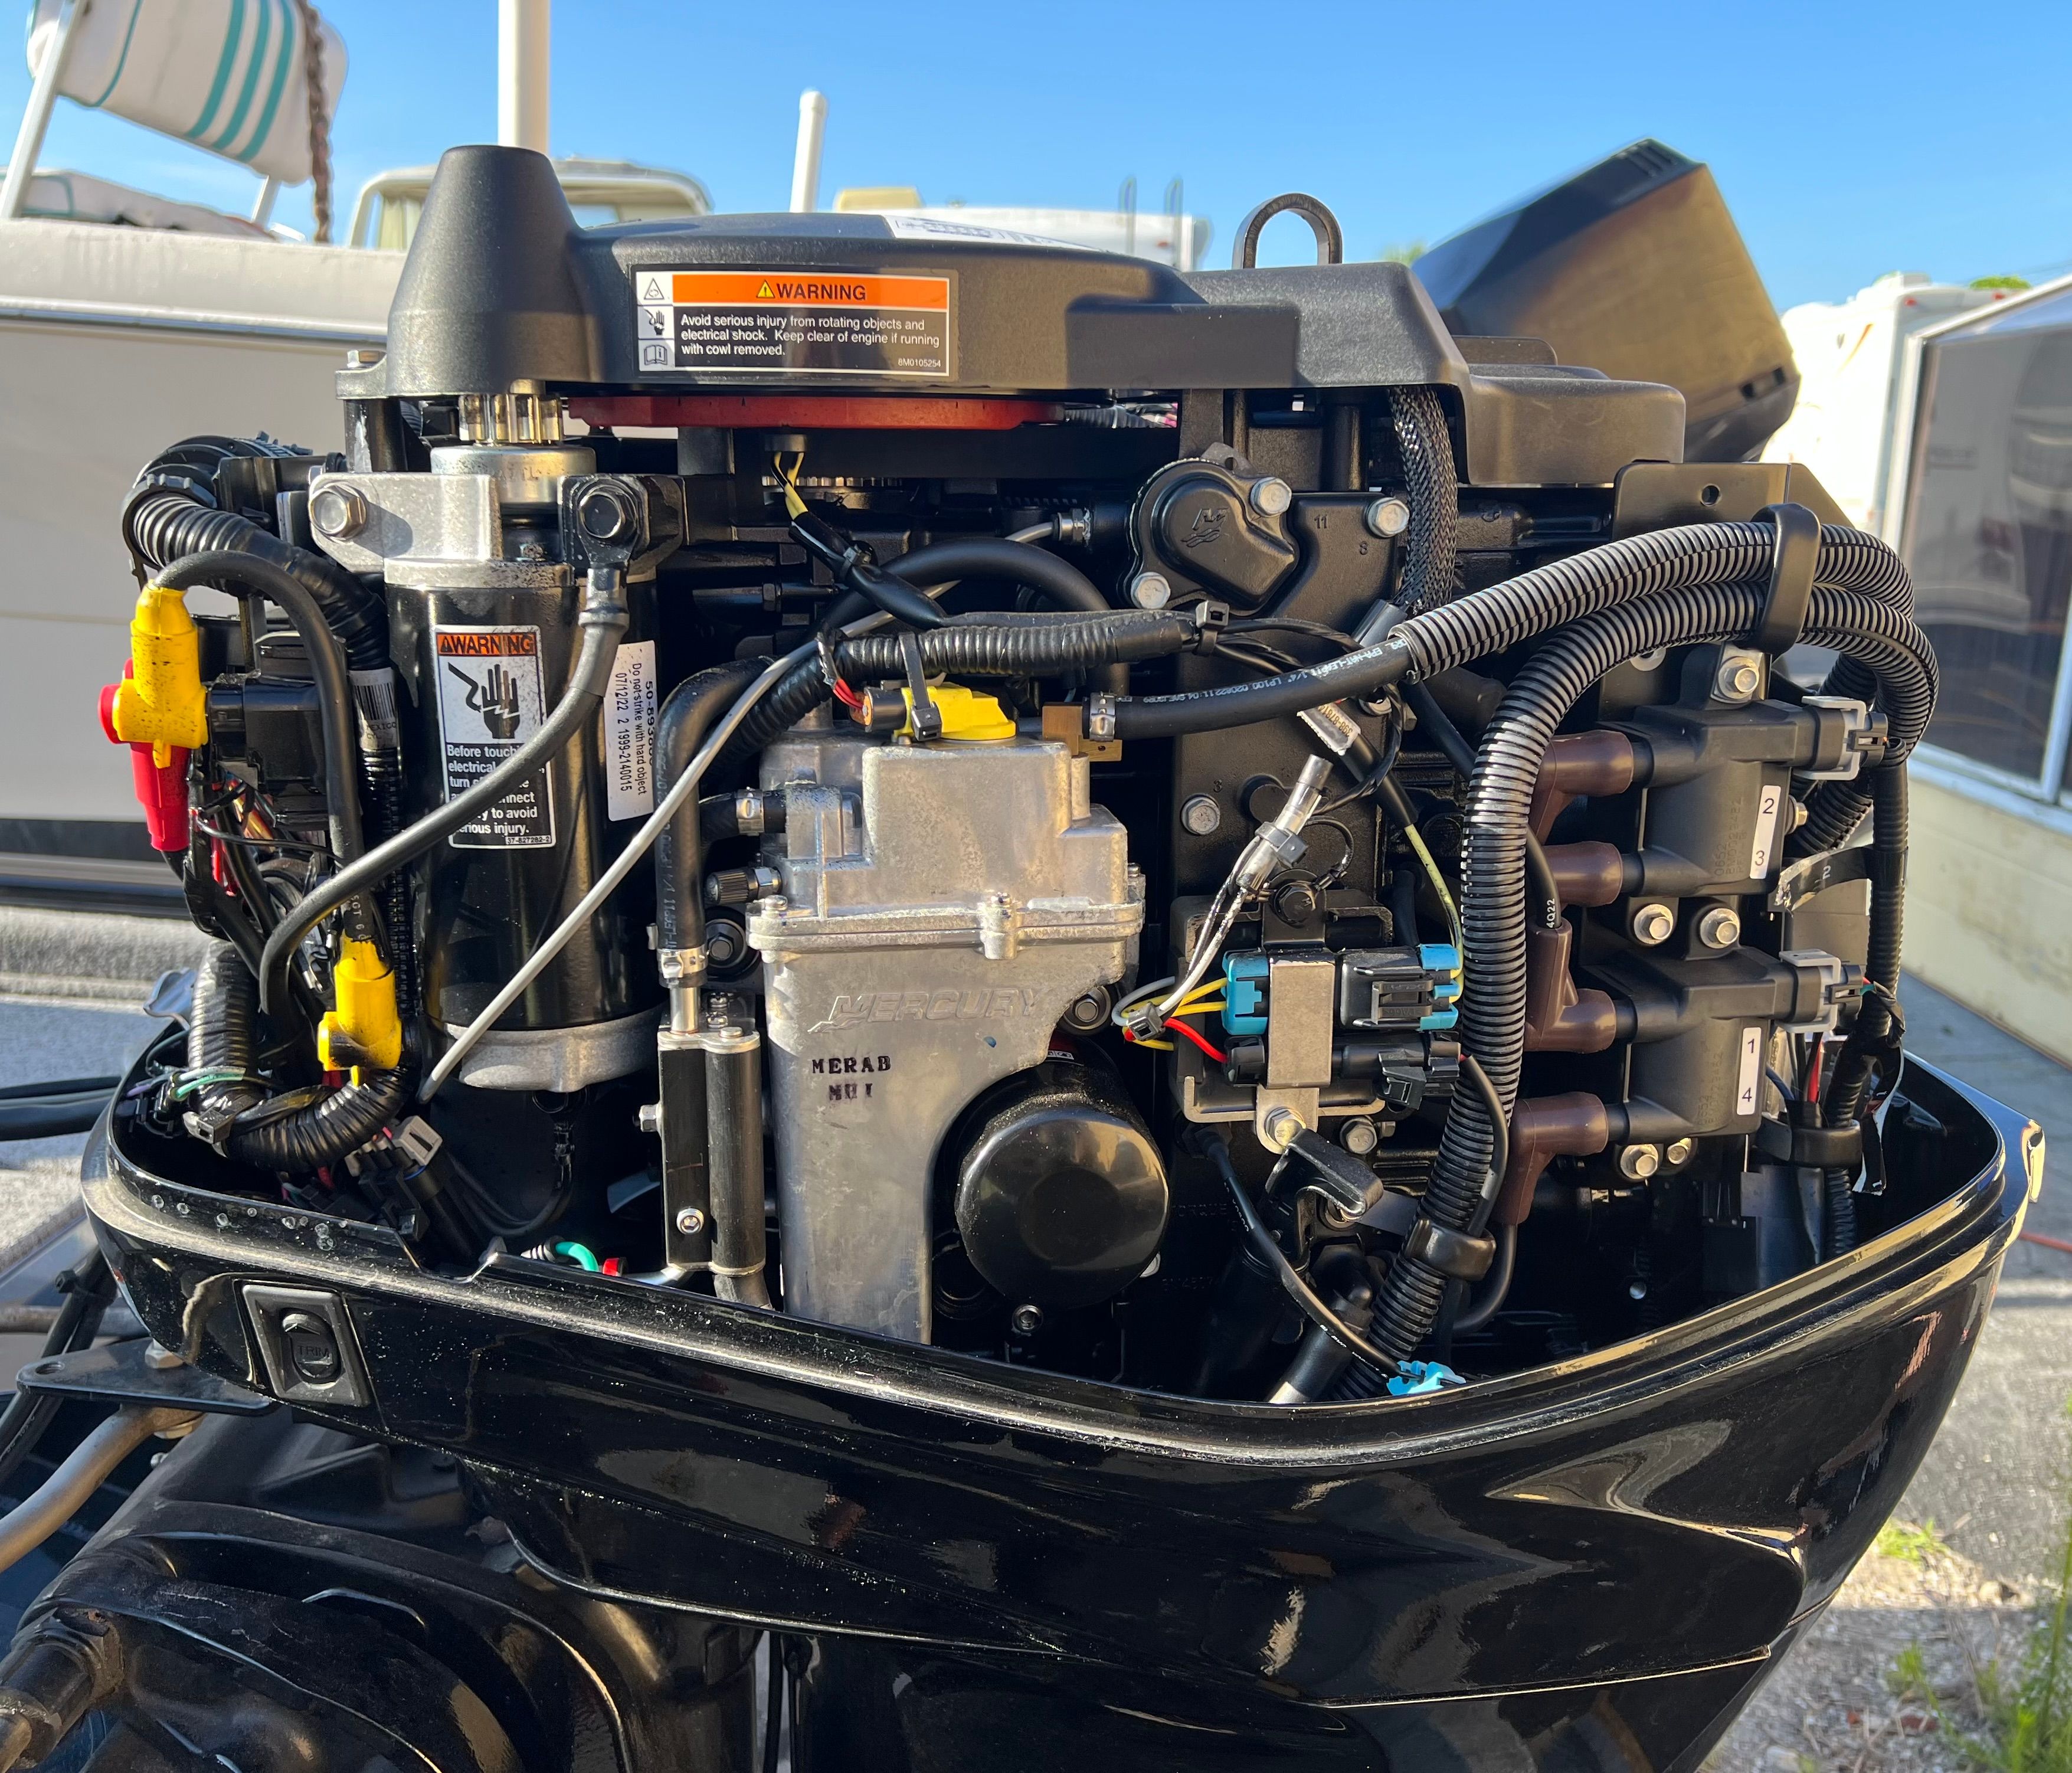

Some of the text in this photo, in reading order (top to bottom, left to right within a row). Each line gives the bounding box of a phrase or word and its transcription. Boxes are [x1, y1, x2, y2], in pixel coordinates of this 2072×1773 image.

[777, 283, 866, 301] WARNING
[680, 314, 925, 332] Avoid serious injury from rotating objects and
[681, 329, 939, 348] electrical shock. Keep clear of engine if running
[681, 343, 785, 356] with cowl removed.
[898, 358, 942, 368] 8M0105254
[615, 673, 628, 711] 07/12/22
[632, 663, 648, 795] Do not strike with hard object
[447, 744, 482, 757] Before
[449, 760, 496, 773] electrical
[618, 729, 632, 791] 1999-2140015
[450, 776, 470, 788] turn
[492, 807, 503, 819] to
[506, 806, 538, 819] avoid
[1762, 797, 1775, 814] 2
[453, 822, 529, 836] erious injury.
[1754, 850, 1765, 866] 3
[1546, 897, 1556, 928] 4Q22
[826, 988, 1041, 1025] MERCURY
[1747, 1038, 1755, 1054] 1
[812, 1055, 891, 1074] MERAB
[1742, 1087, 1752, 1103] 4
